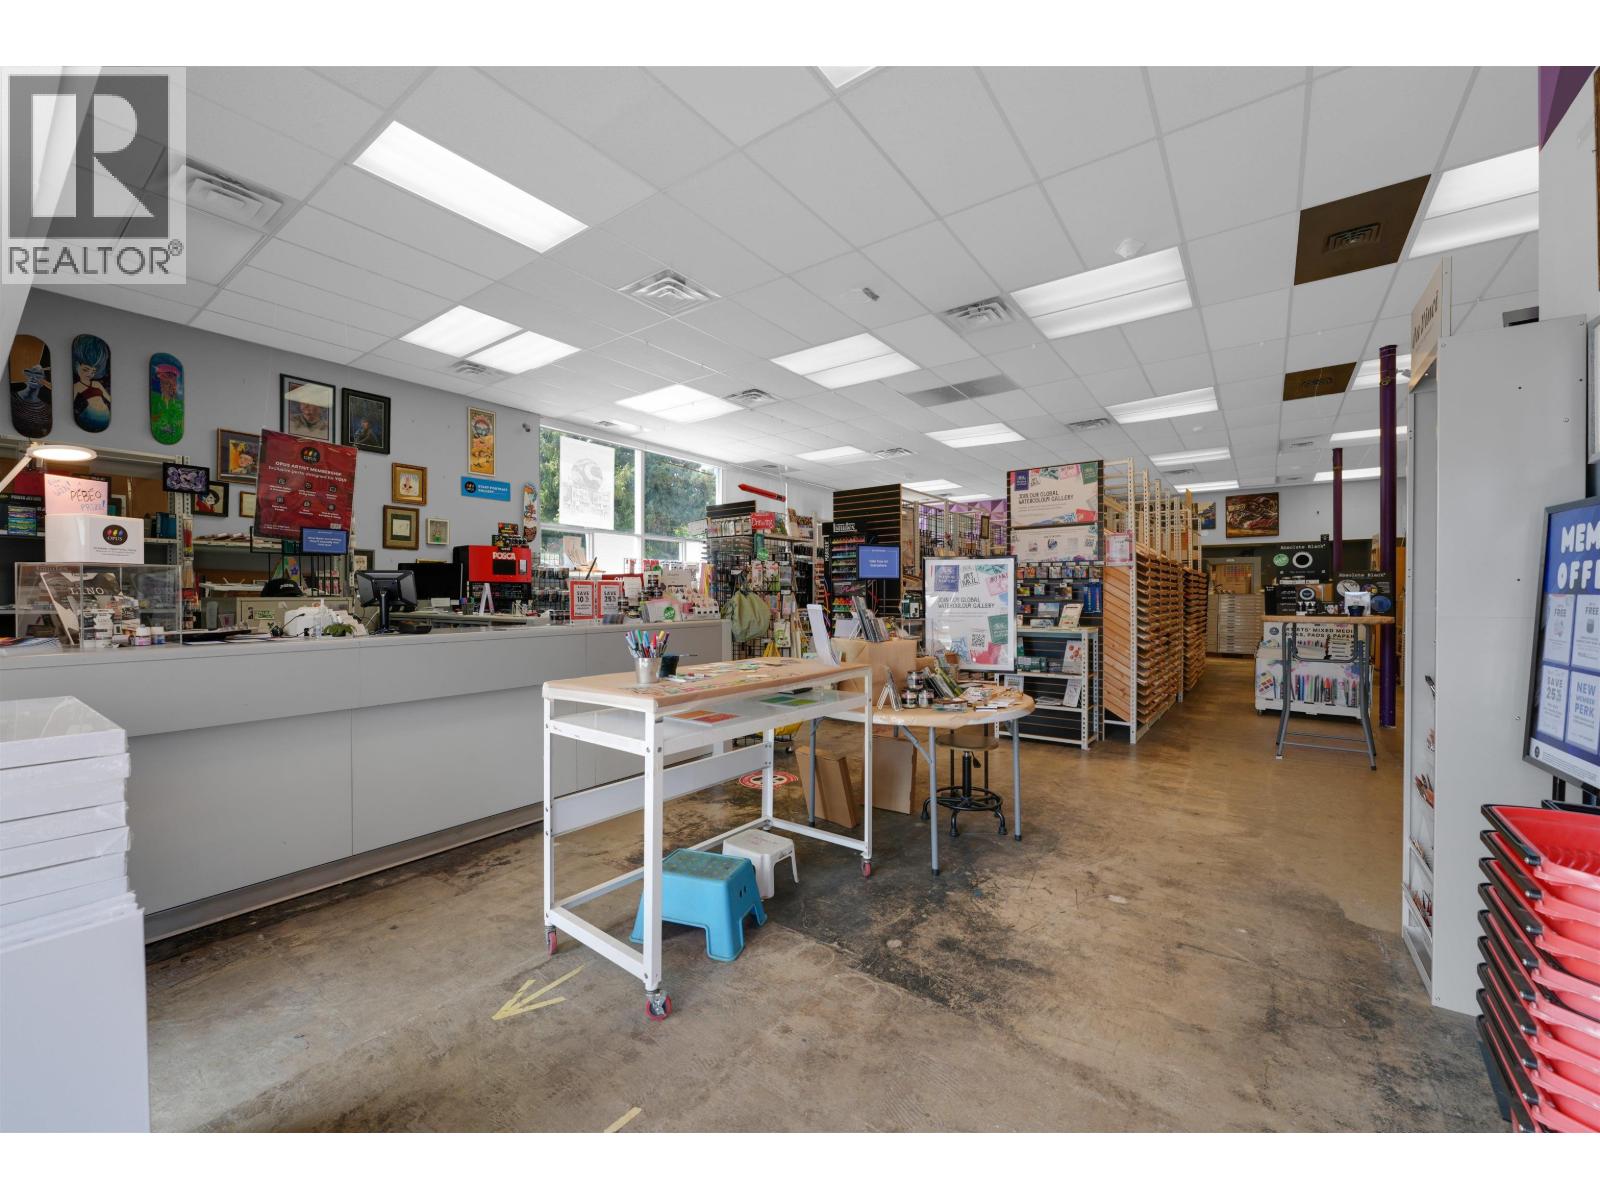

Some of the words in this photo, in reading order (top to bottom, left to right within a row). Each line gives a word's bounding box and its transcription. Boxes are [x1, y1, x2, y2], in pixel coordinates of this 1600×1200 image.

[310, 468, 342, 476] MEMBERSHIP
[492, 552, 516, 560] POSCA
[70, 587, 104, 595] LINO
[1585, 606, 1599, 616] FREE
[1547, 676, 1563, 689] SAVE
[1576, 681, 1597, 697] NEW
[1574, 702, 1595, 718] PERK
